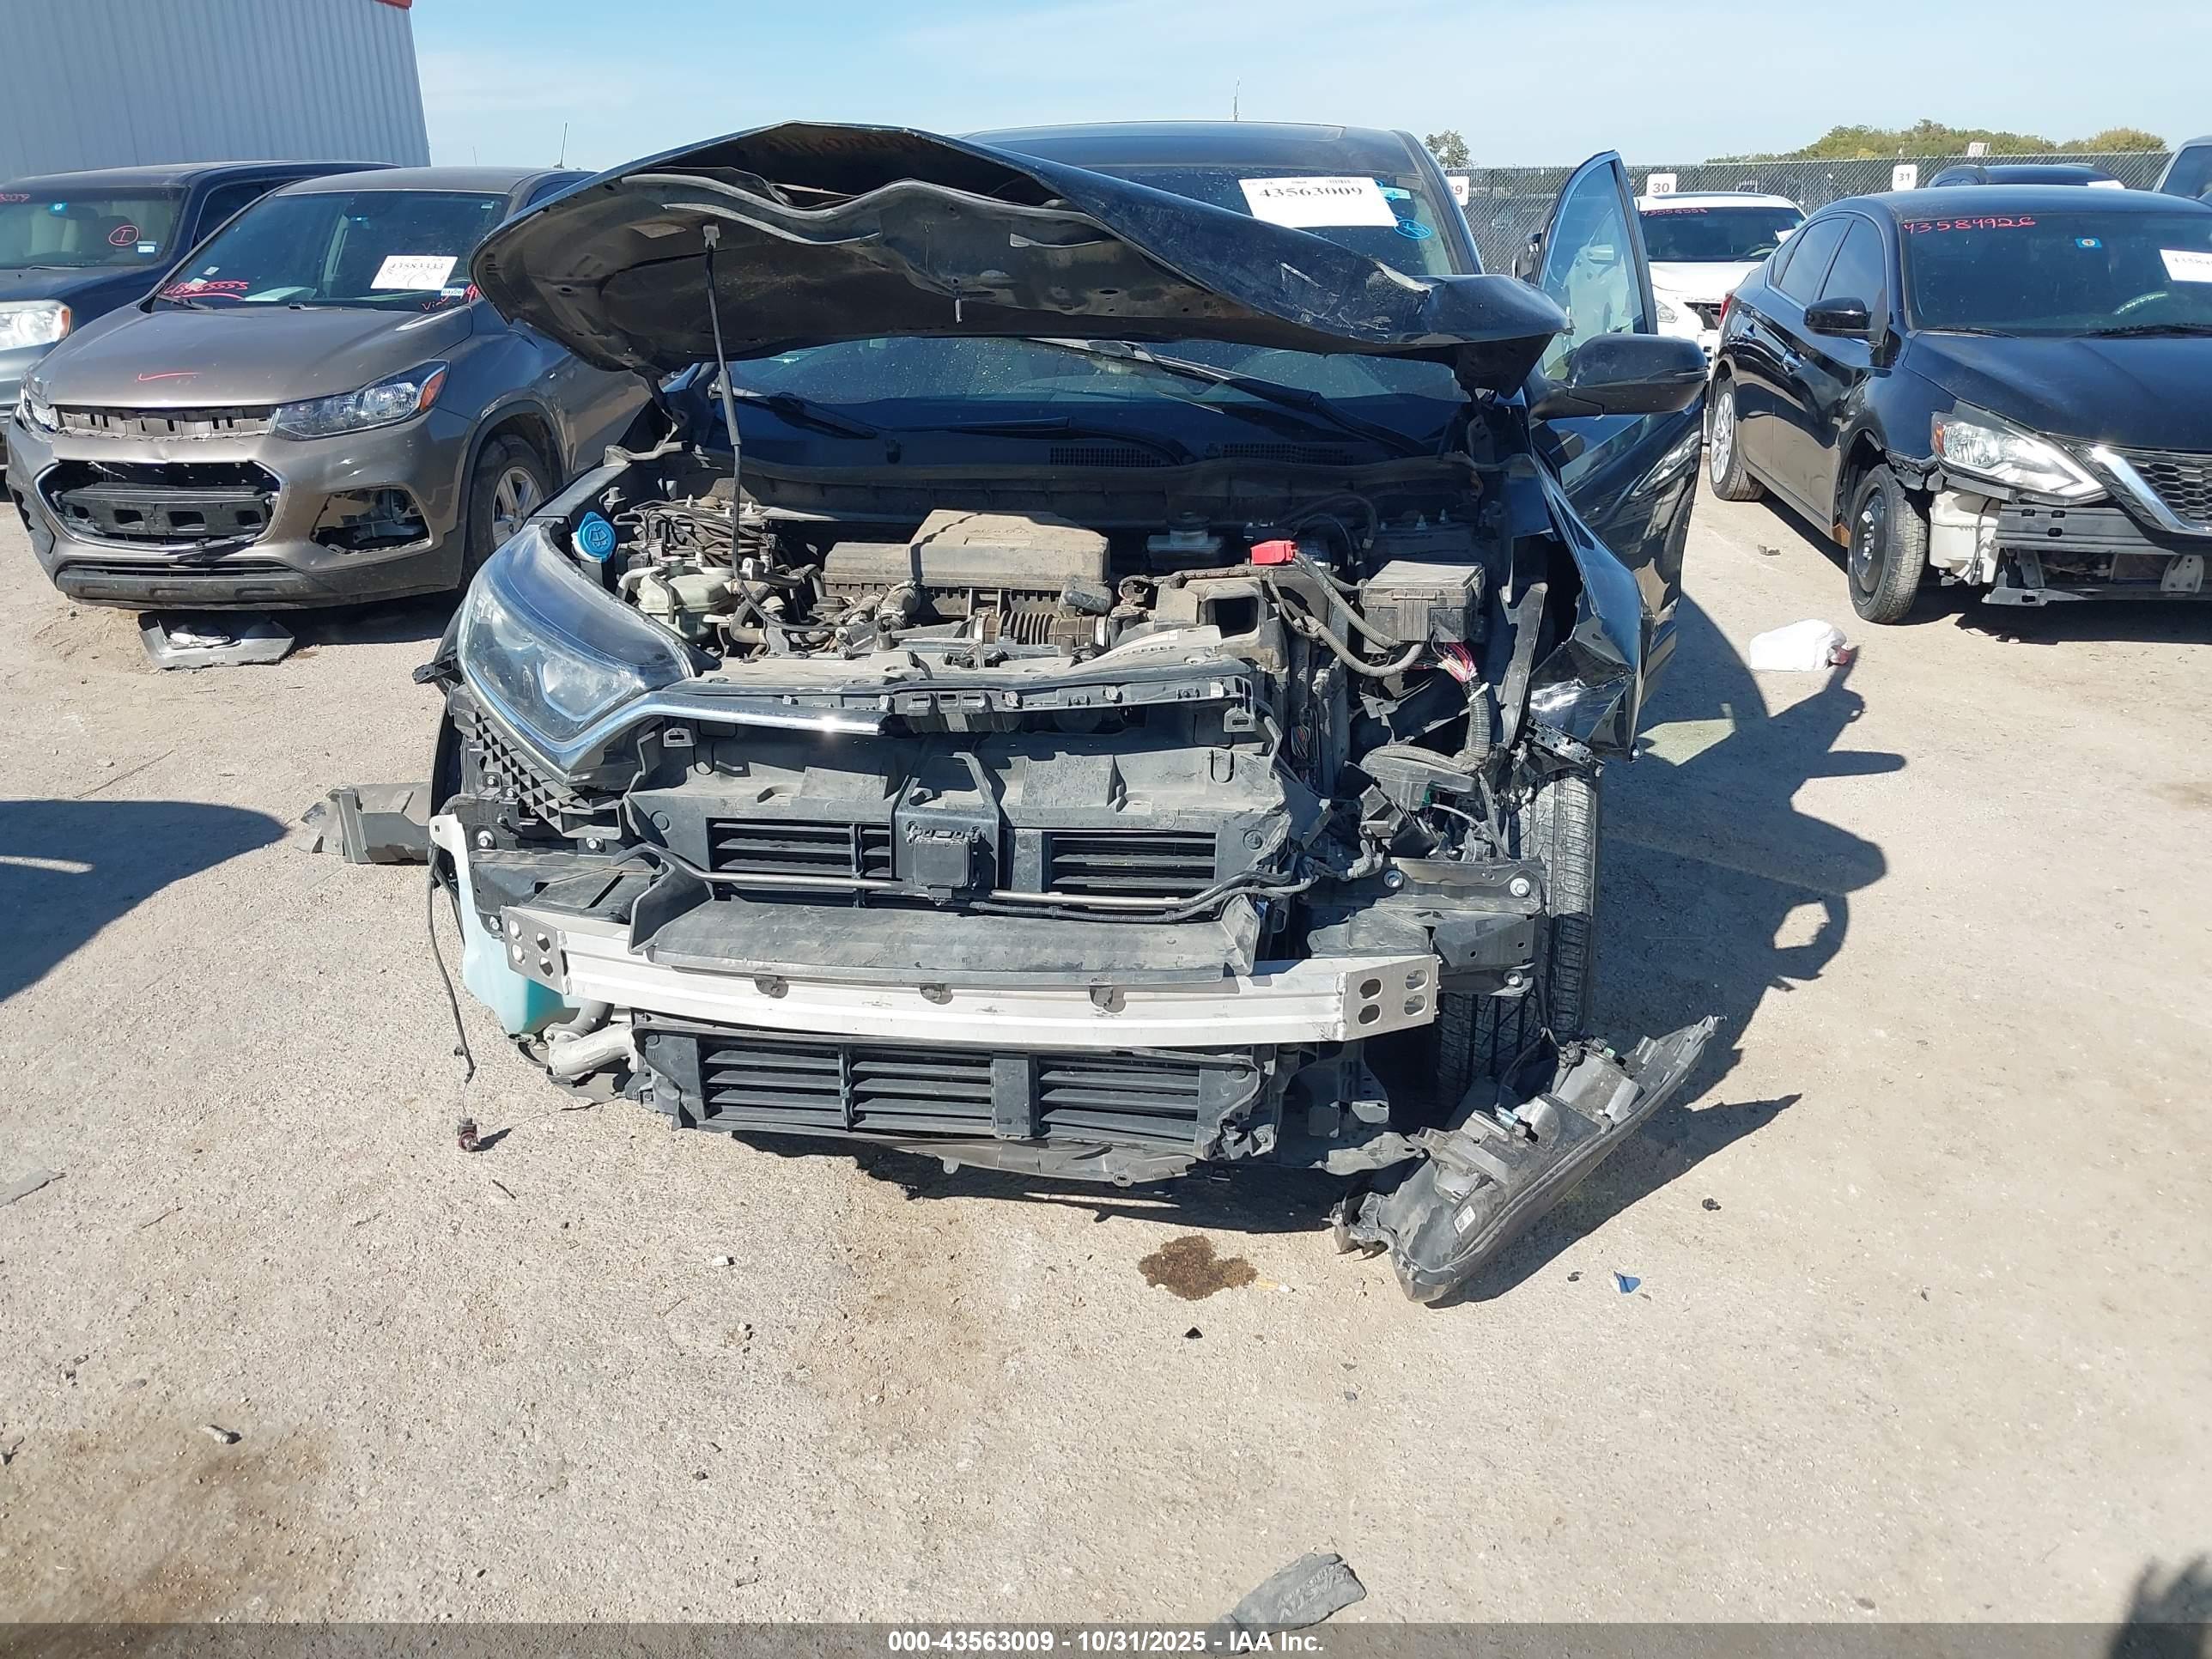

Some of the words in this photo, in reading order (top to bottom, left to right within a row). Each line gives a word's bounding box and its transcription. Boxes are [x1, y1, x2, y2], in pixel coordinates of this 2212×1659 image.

[1898, 173, 1911, 182] 31
[1259, 187, 1363, 198] 43563009
[1652, 182, 1670, 193] 30
[1903, 216, 2037, 234] 43584926
